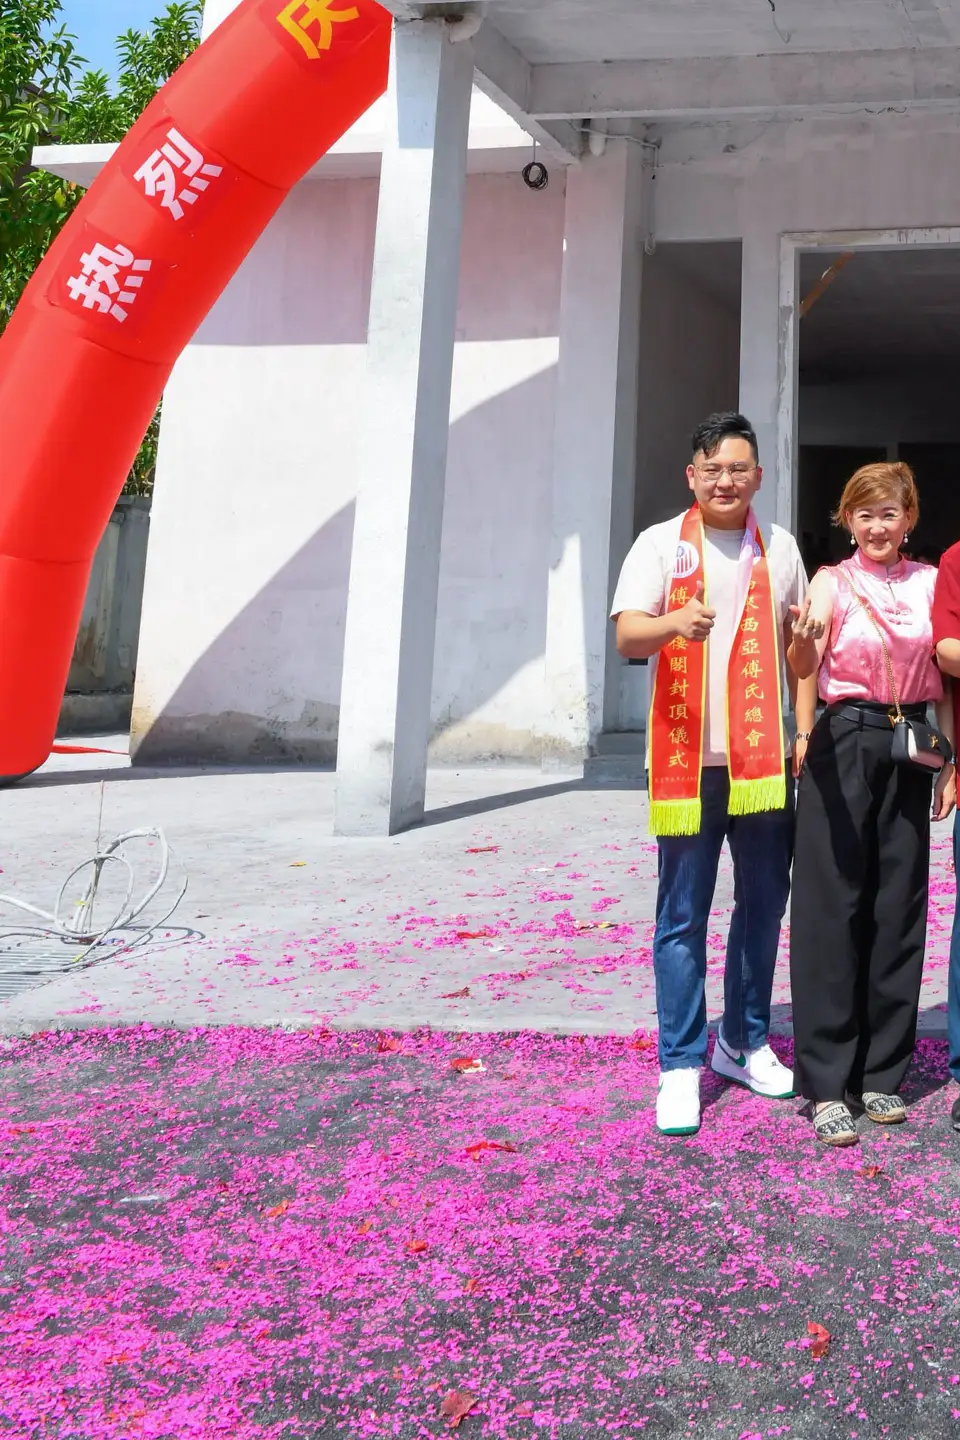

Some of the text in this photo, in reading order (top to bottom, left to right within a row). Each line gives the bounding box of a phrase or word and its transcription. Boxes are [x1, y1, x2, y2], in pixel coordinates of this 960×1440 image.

[668, 586, 690, 768] 傅樓閣封頂儀式
